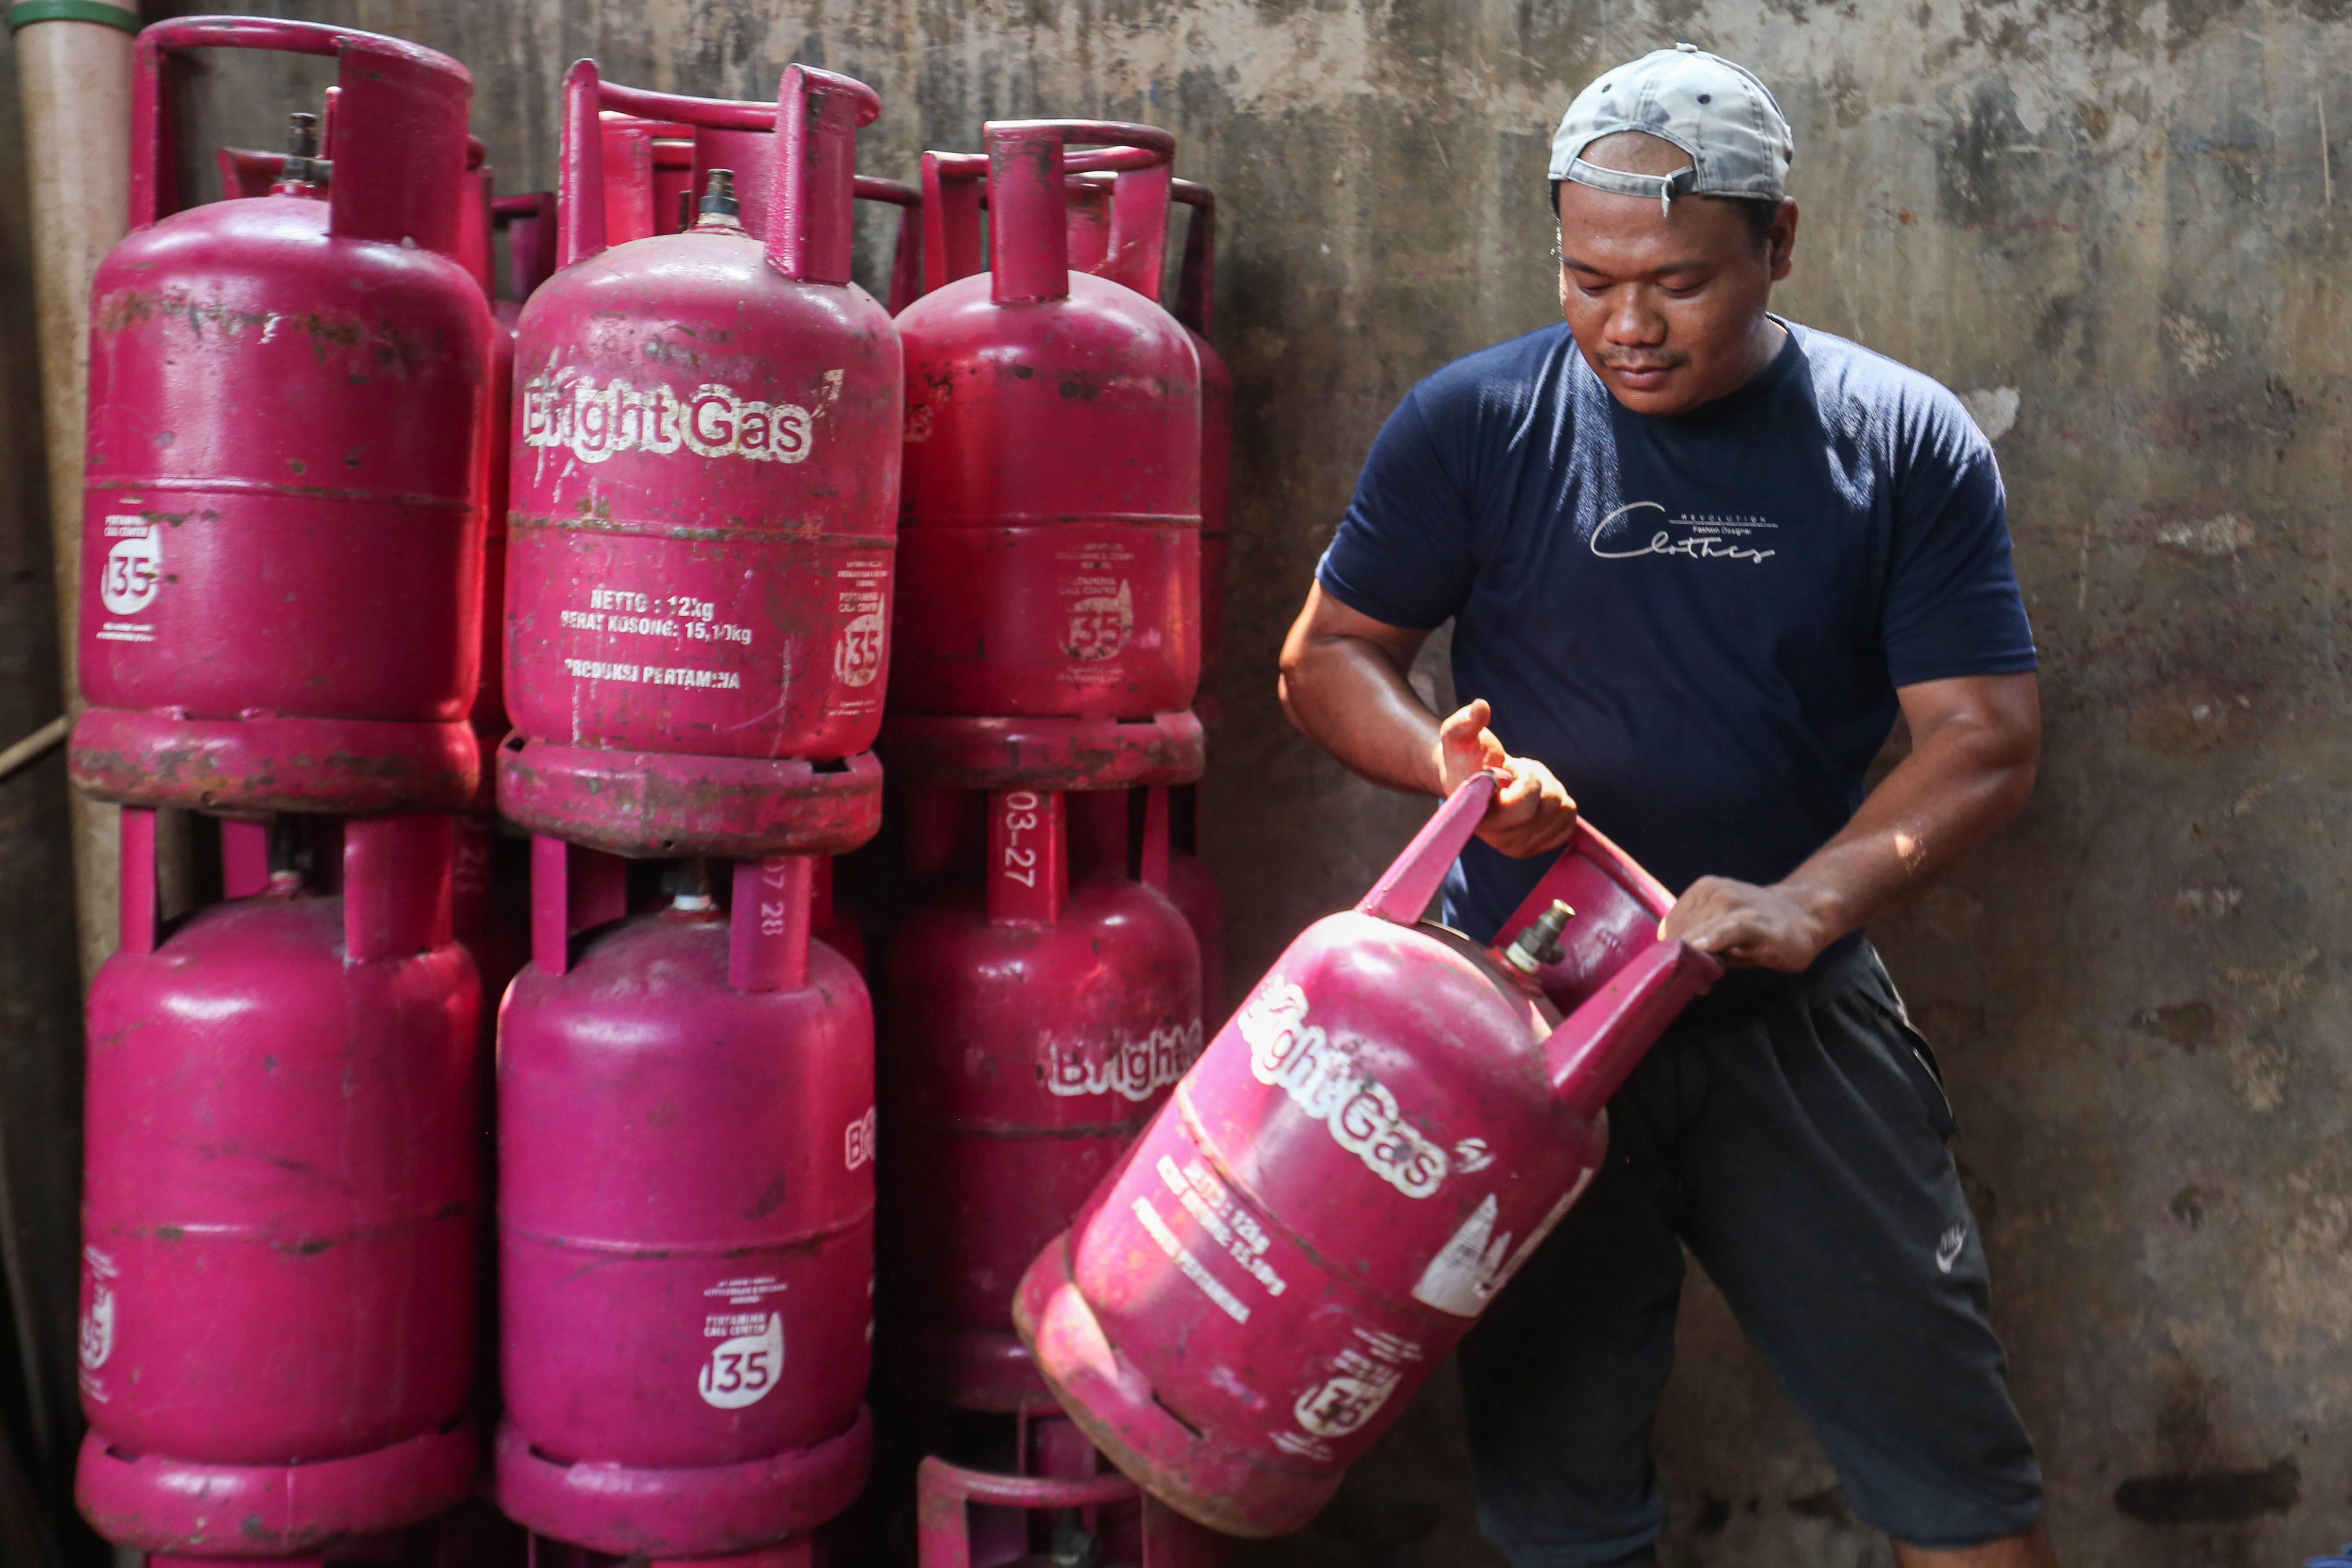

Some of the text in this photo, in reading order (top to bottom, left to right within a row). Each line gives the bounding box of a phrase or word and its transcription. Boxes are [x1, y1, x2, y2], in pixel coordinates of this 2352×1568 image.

[679, 384, 812, 464] Gas
[1591, 501, 1775, 564] Clothes
[1693, 525, 1752, 537] Fashion Designer
[590, 589, 647, 613] NETTO
[667, 595, 715, 622] 12kg
[1005, 791, 1038, 888] 03-27
[1328, 1081, 1448, 1199] Gas
[704, 1350, 768, 1394] 135
